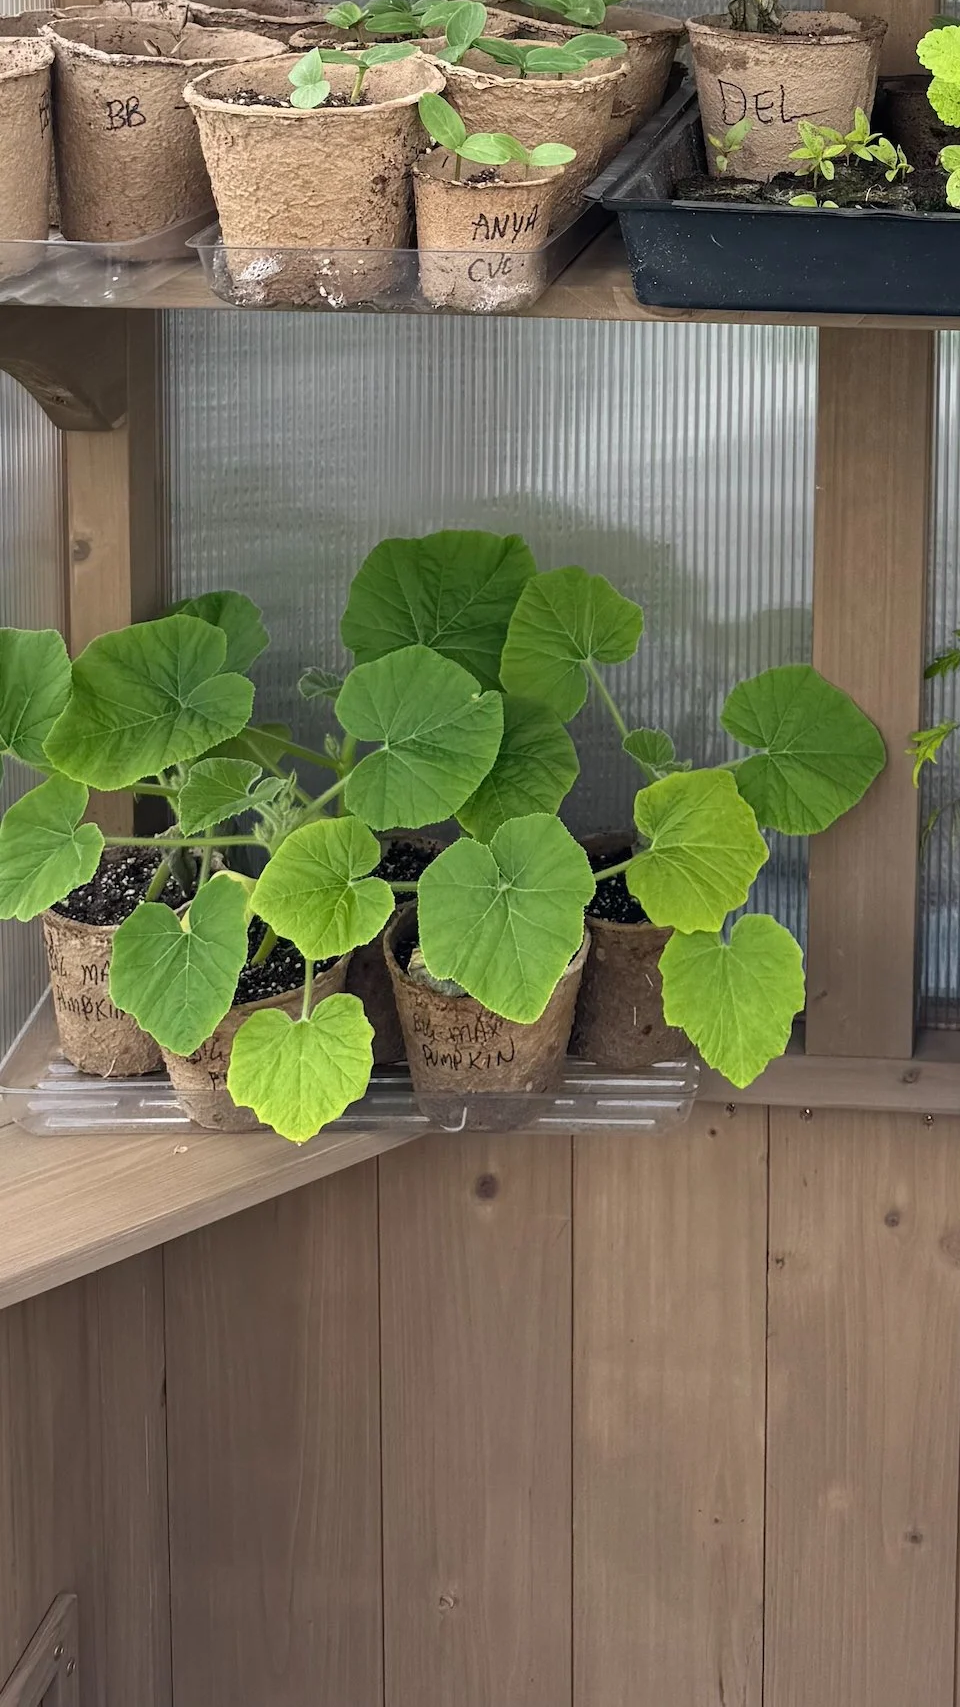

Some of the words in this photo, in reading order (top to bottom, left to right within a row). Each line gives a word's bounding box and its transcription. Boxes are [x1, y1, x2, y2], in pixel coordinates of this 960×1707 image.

[105, 95, 147, 131] BB
[717, 78, 830, 126] DEL
[471, 203, 540, 244] ANYA
[80, 959, 111, 986] MA
[421, 1033, 516, 1072] PUMPKIN
